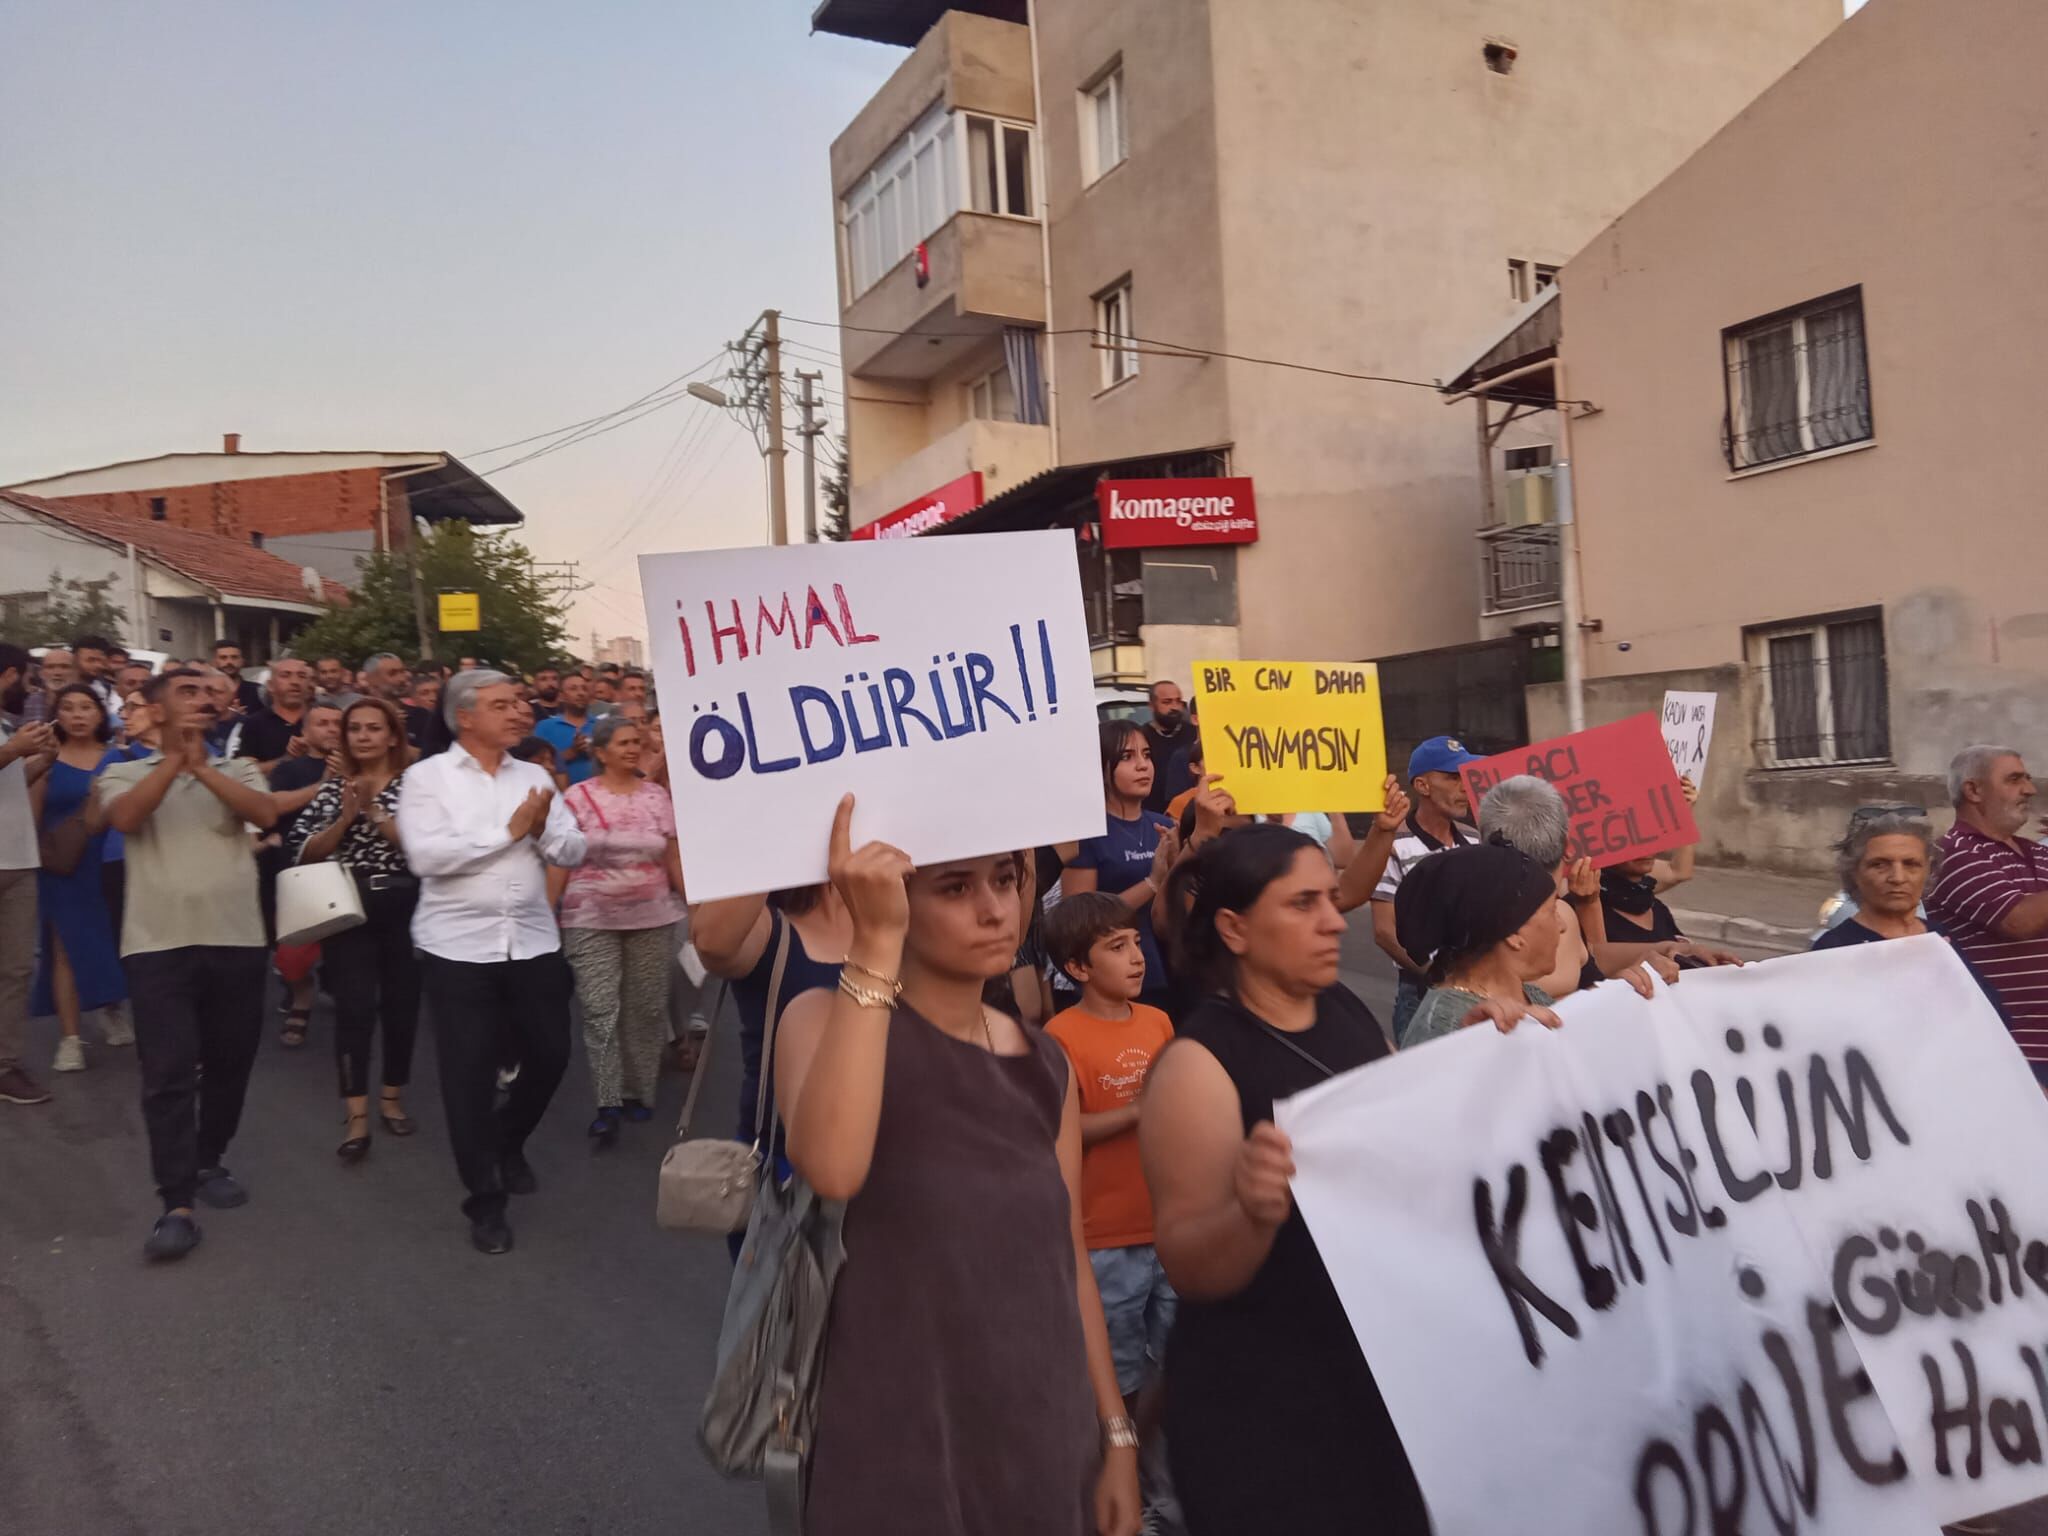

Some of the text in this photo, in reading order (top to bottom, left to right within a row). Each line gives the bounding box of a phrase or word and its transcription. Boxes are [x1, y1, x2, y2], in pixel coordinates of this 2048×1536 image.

[1110, 489, 1235, 527] komagene
[676, 583, 880, 677] İHMAL
[688, 619, 1059, 780] ÖLDÜRÜR!!
[1203, 667, 1366, 694] BİR CAN DAHA
[1223, 724, 1361, 773] YANMASIN
